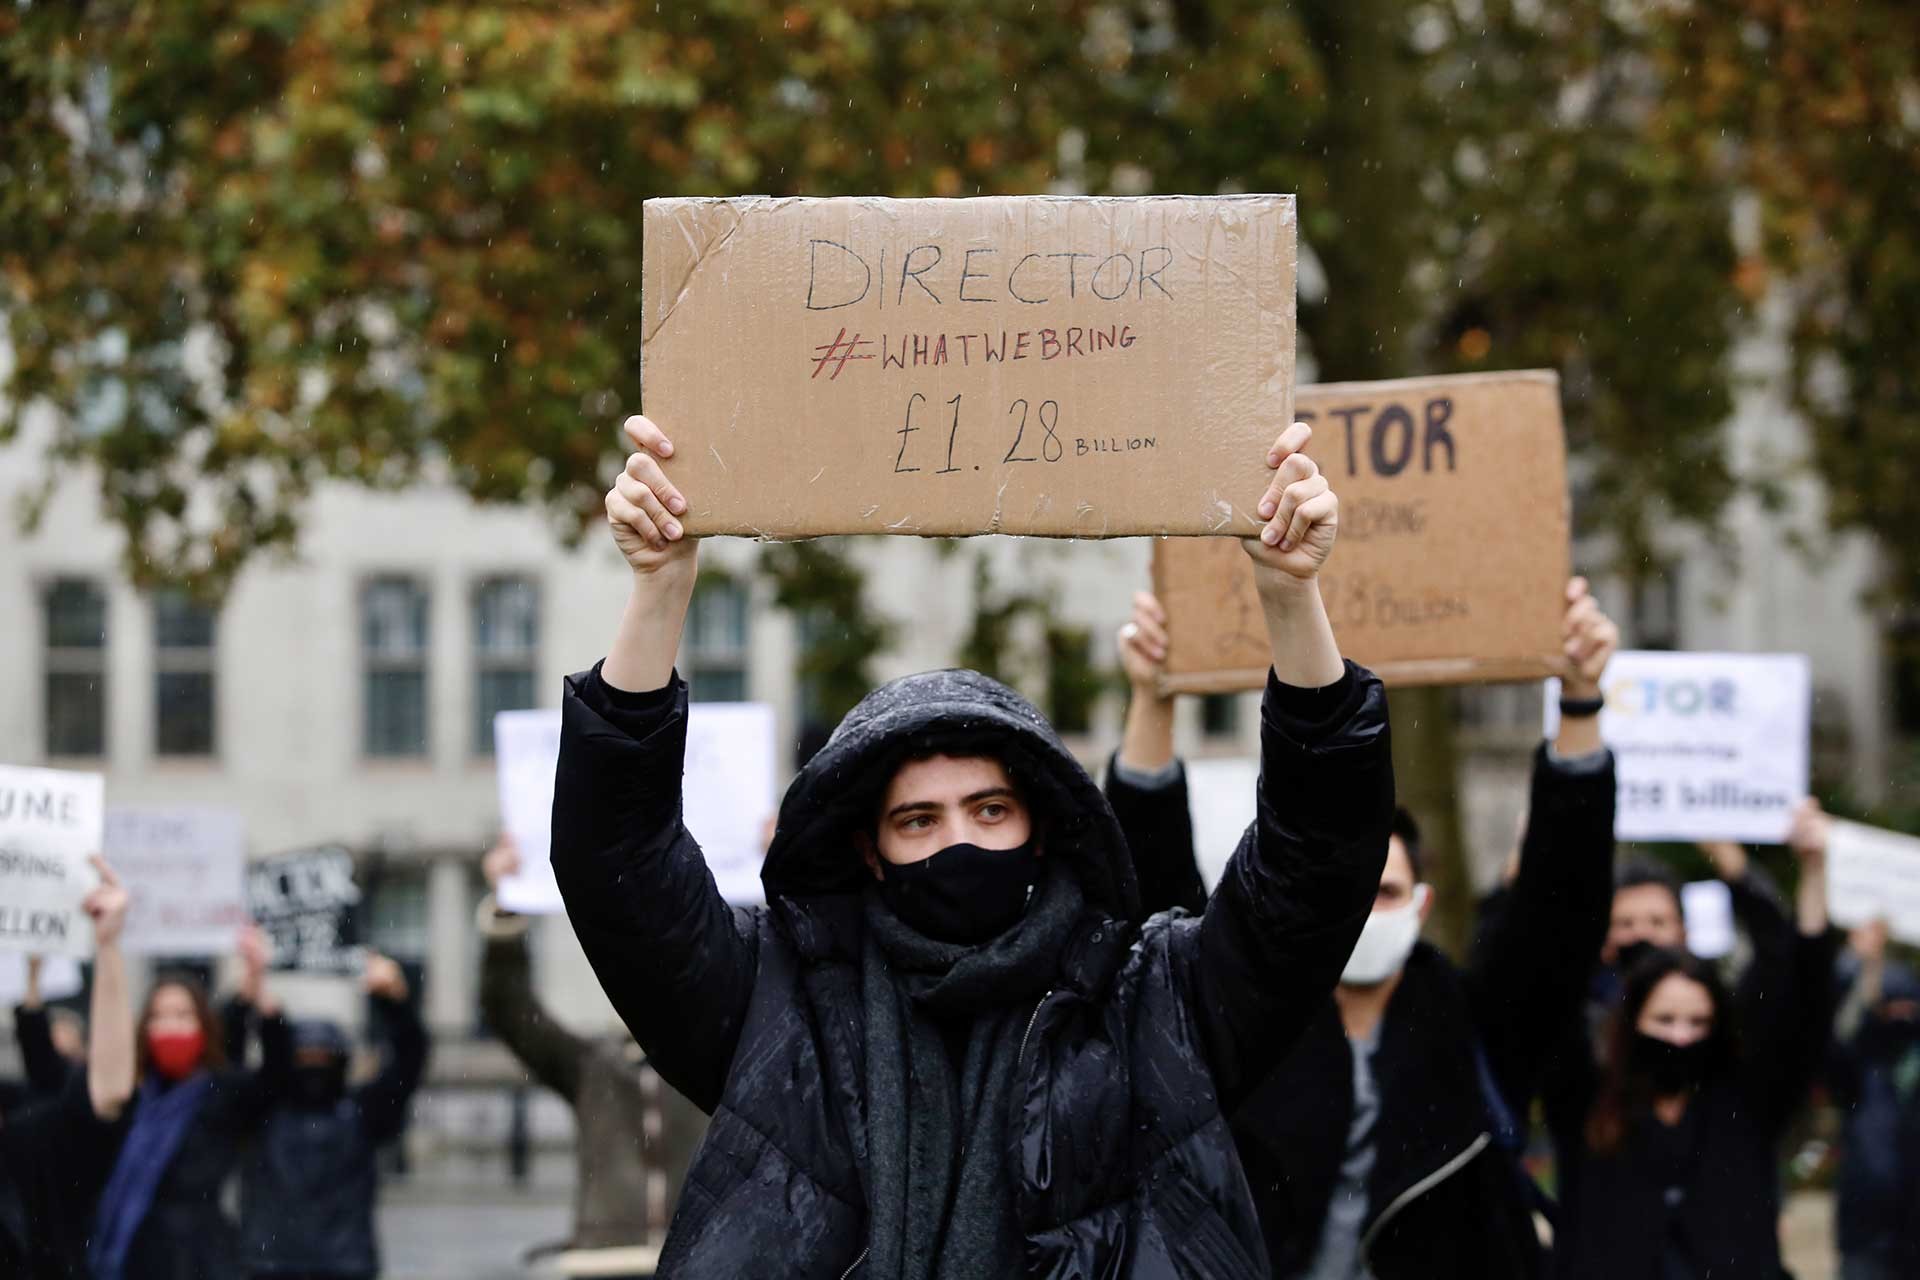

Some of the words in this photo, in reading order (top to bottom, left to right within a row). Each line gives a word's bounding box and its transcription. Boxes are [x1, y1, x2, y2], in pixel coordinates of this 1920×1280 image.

[805, 238, 1175, 311] DIRECTOR
[811, 326, 1138, 380] #WHATWEBRING
[1075, 436, 1157, 456] BILLION
